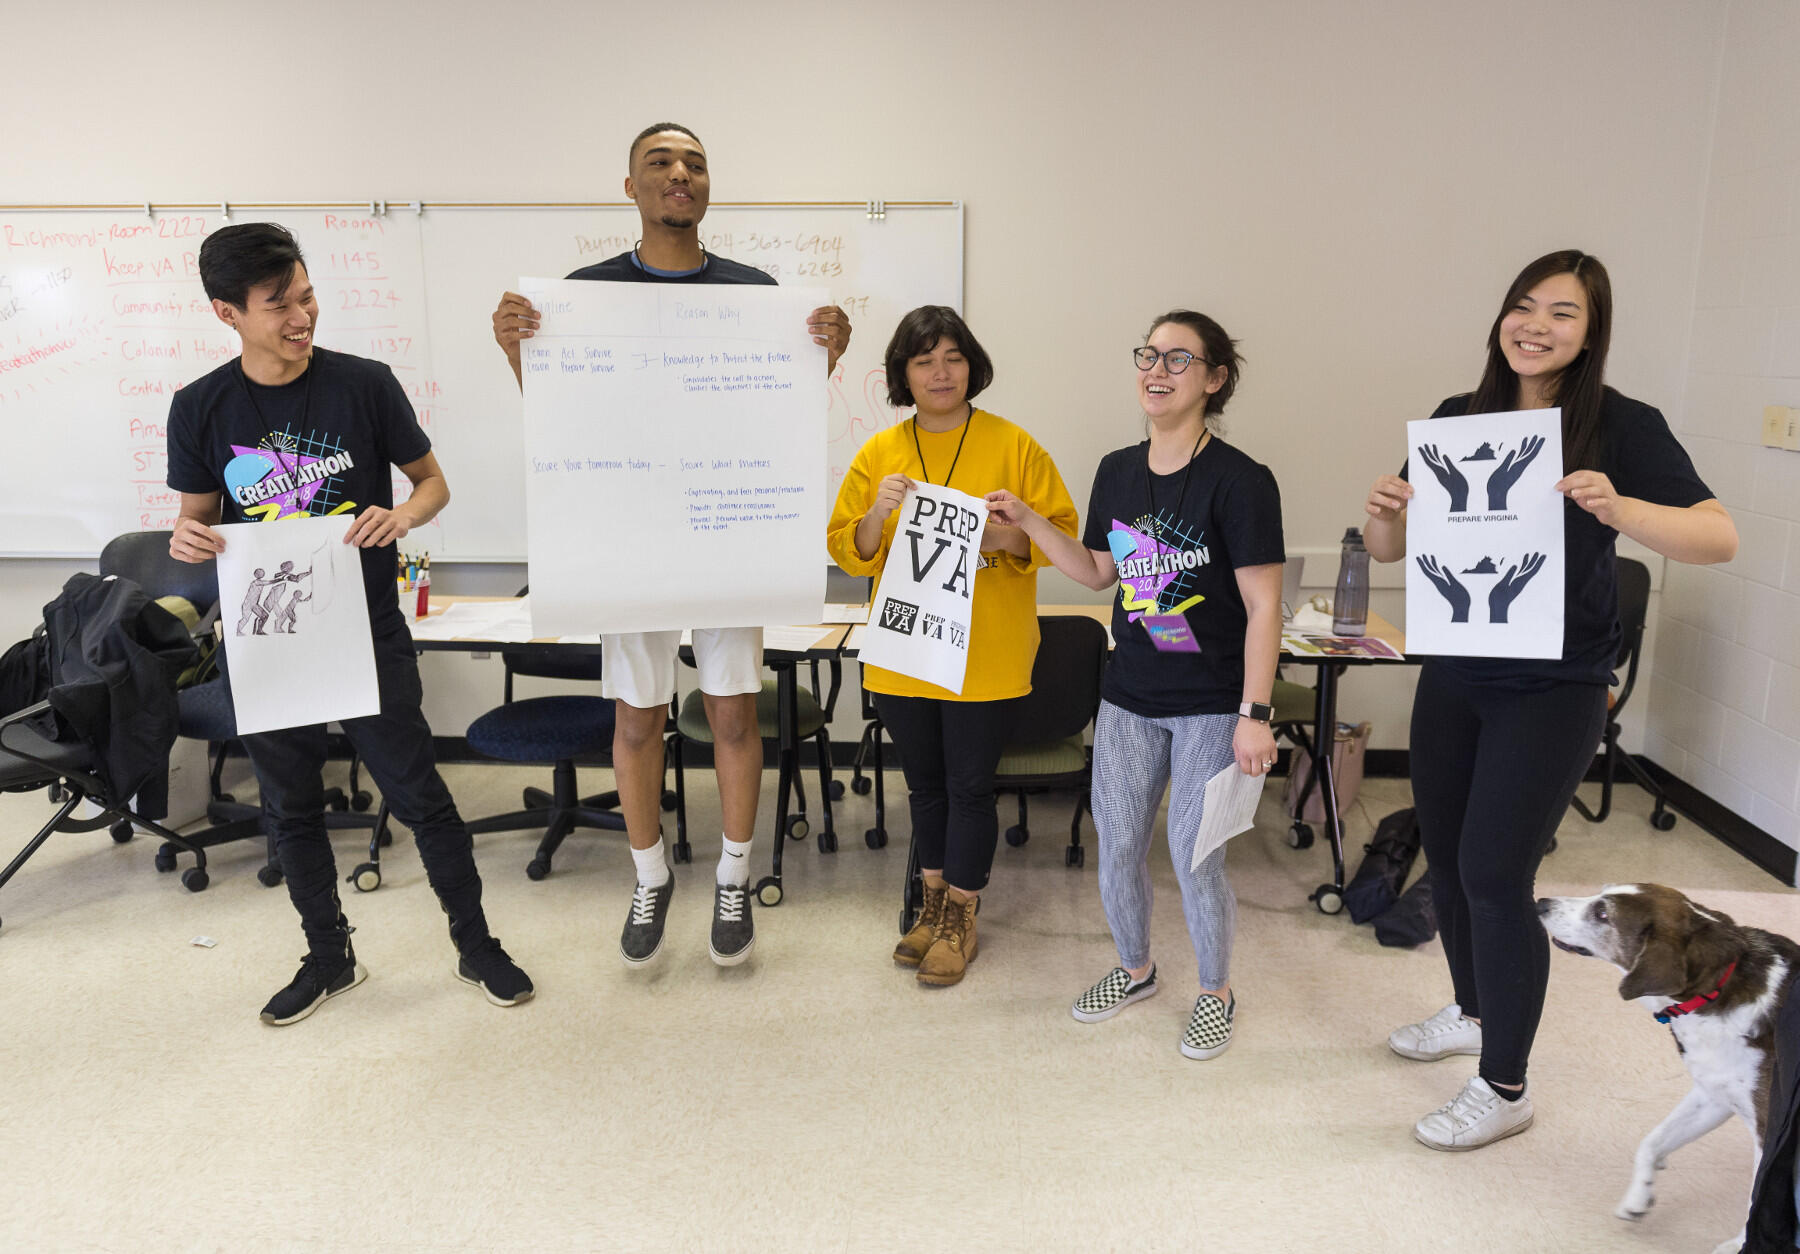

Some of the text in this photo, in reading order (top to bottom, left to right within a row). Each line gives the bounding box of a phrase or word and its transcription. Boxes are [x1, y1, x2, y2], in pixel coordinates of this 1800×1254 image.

[325, 214, 385, 235] Room
[102, 248, 145, 277] Keep
[151, 257, 174, 277] VA
[331, 252, 380, 271] 1145
[112, 293, 184, 318] Community
[338, 288, 403, 310] 2224
[674, 301, 709, 320] Reason
[718, 305, 740, 327] Why
[120, 340, 183, 361] Colonial
[370, 337, 413, 356] 1137
[527, 346, 612, 360] Learn Act Survive
[560, 360, 585, 374] Prepare
[663, 352, 705, 368] Knowledge
[709, 352, 719, 366] to
[722, 352, 748, 366] Protect
[751, 353, 763, 364] the
[532, 457, 558, 473] Secure
[627, 456, 652, 473] today
[680, 458, 703, 472] Secure
[283, 486, 311, 506] 218
[909, 495, 979, 543] PREP
[1447, 514, 1518, 524] PREPARE VIRGINIA
[905, 529, 969, 599] VA
[1137, 577, 1164, 592] 208
[885, 600, 917, 617] PREP
[924, 612, 946, 624] PREP
[884, 609, 911, 632] VA
[922, 619, 943, 640] VA
[949, 626, 965, 650] VA
